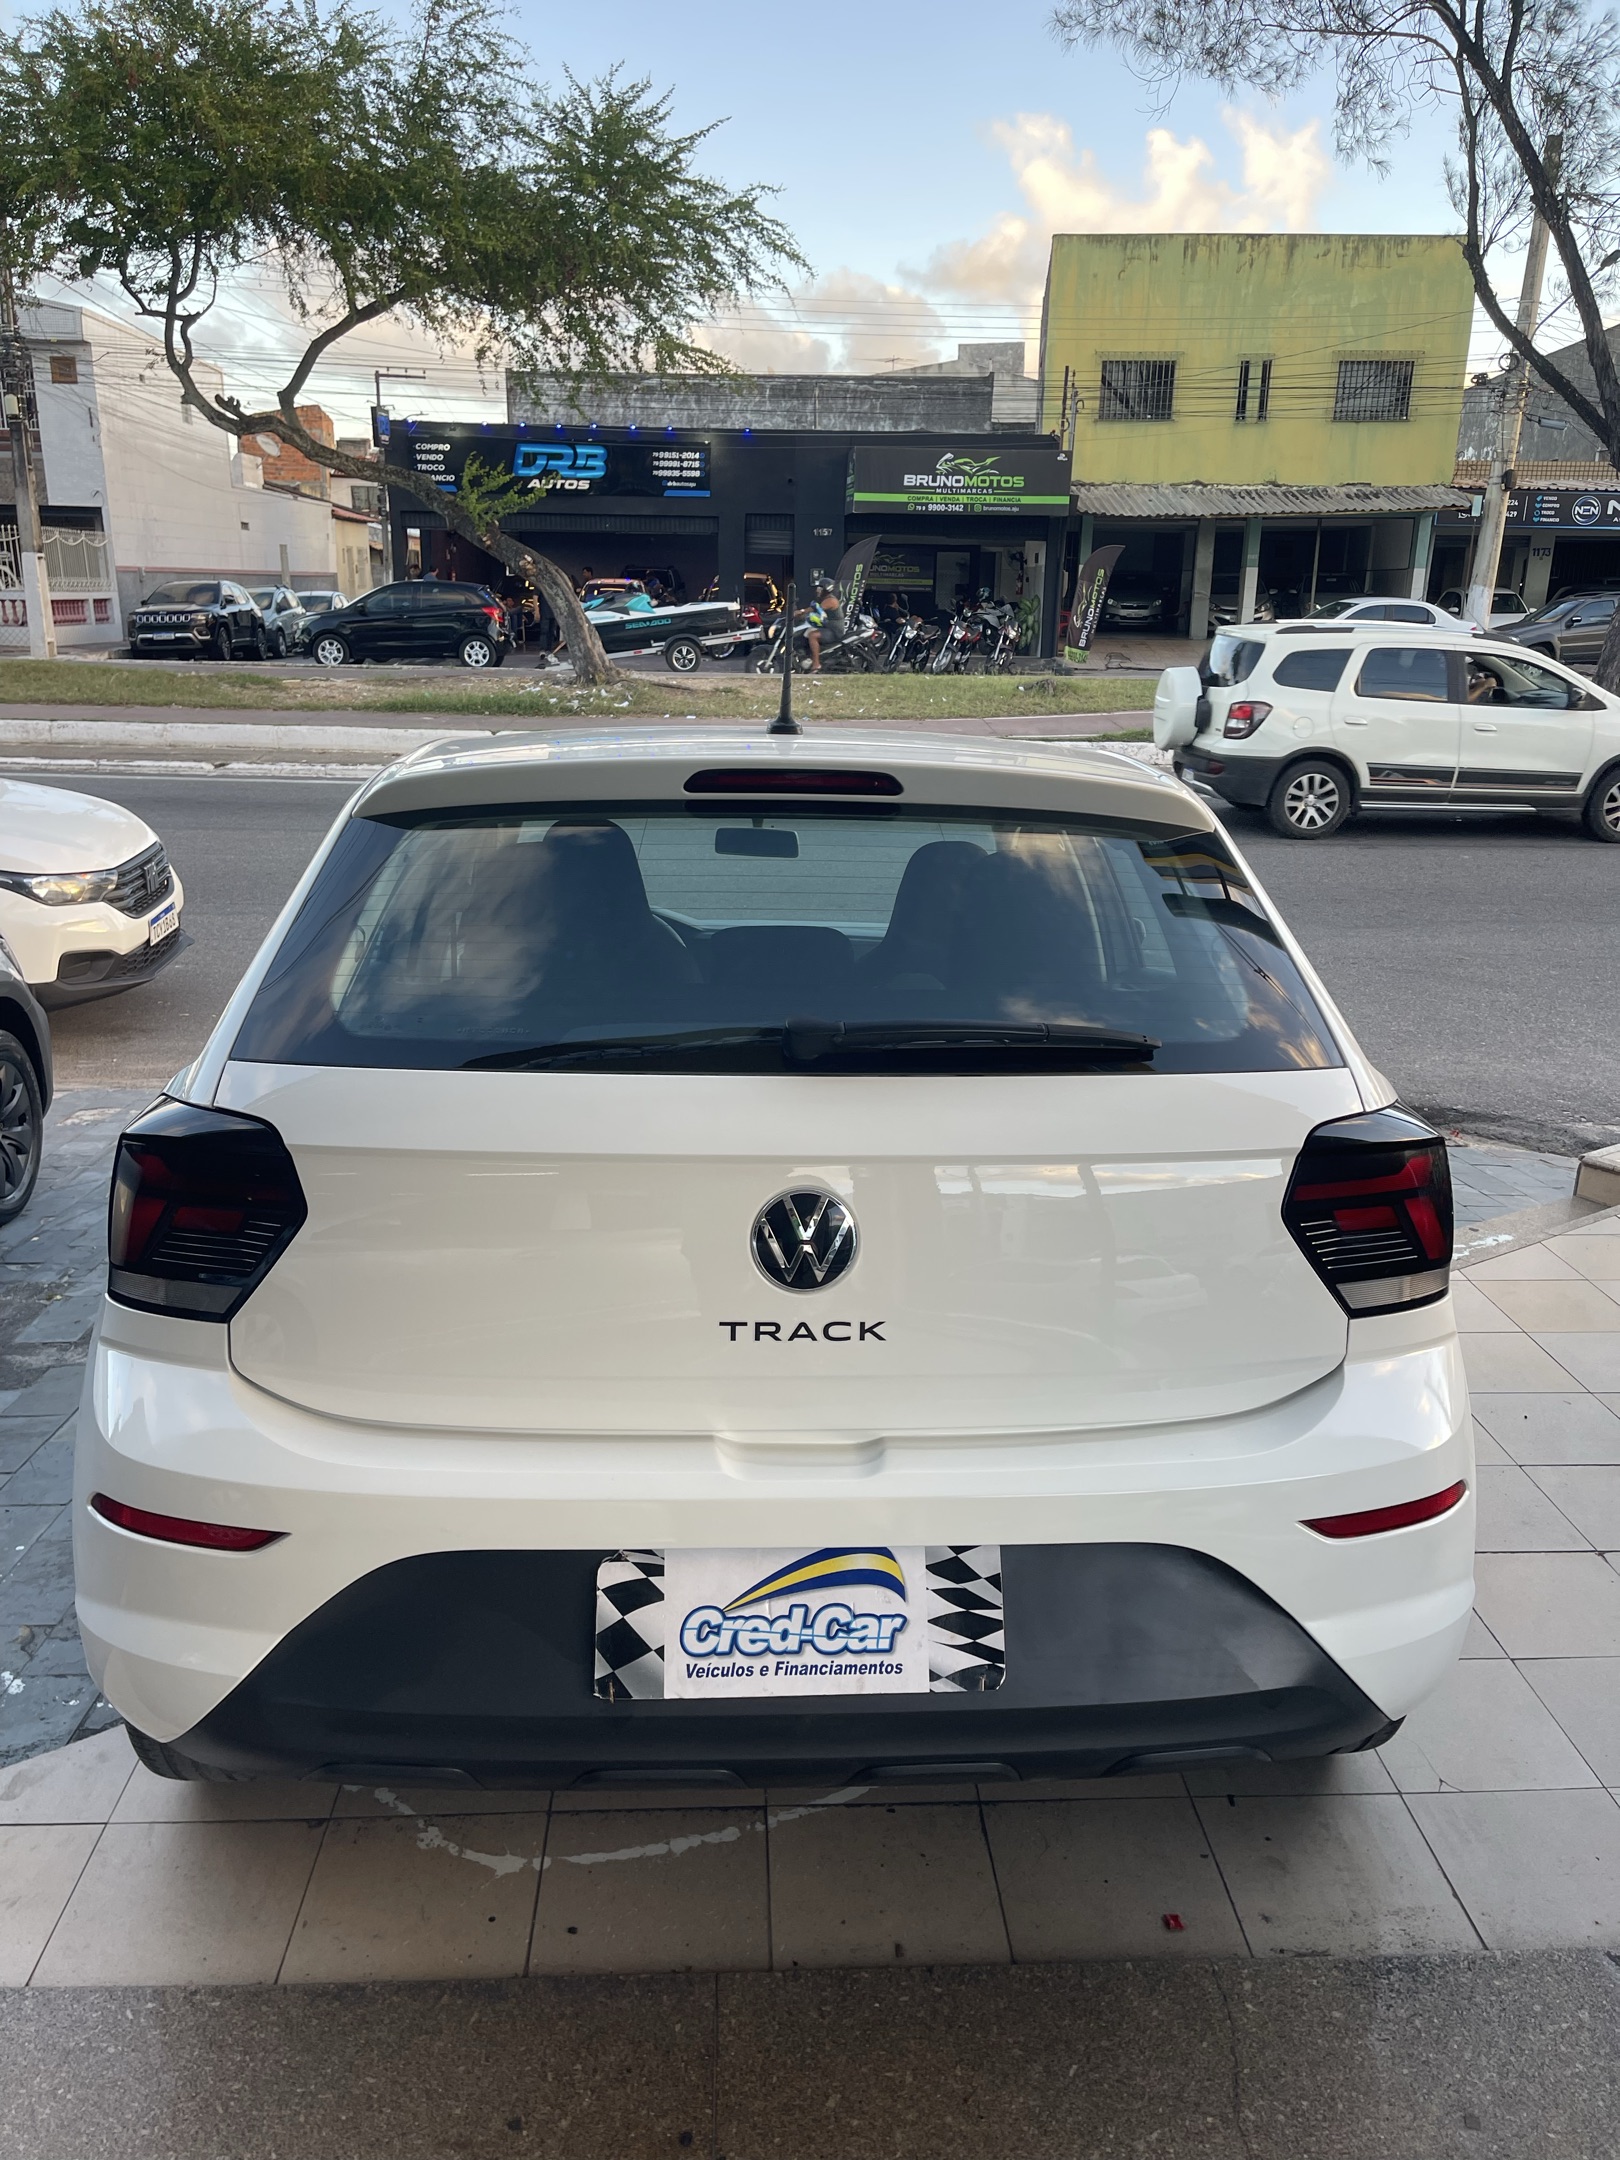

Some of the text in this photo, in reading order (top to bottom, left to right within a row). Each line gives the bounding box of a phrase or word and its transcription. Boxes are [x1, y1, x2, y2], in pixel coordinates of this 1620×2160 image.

[415, 443, 451, 451] COMPRO
[416, 453, 444, 461] VENDO
[513, 442, 608, 479] DRB
[527, 478, 591, 490] AUTOS
[903, 474, 1025, 488] BRUNOMOTOS
[927, 503, 964, 512] 9900-3142
[1532, 547, 1552, 557] 1173
[1078, 568, 1105, 648] BRUNOMOTOS
[719, 1321, 887, 1342] TRACK
[680, 1603, 908, 1658] Cred-Car
[685, 1660, 904, 1679] Veículos e Financiamentos
